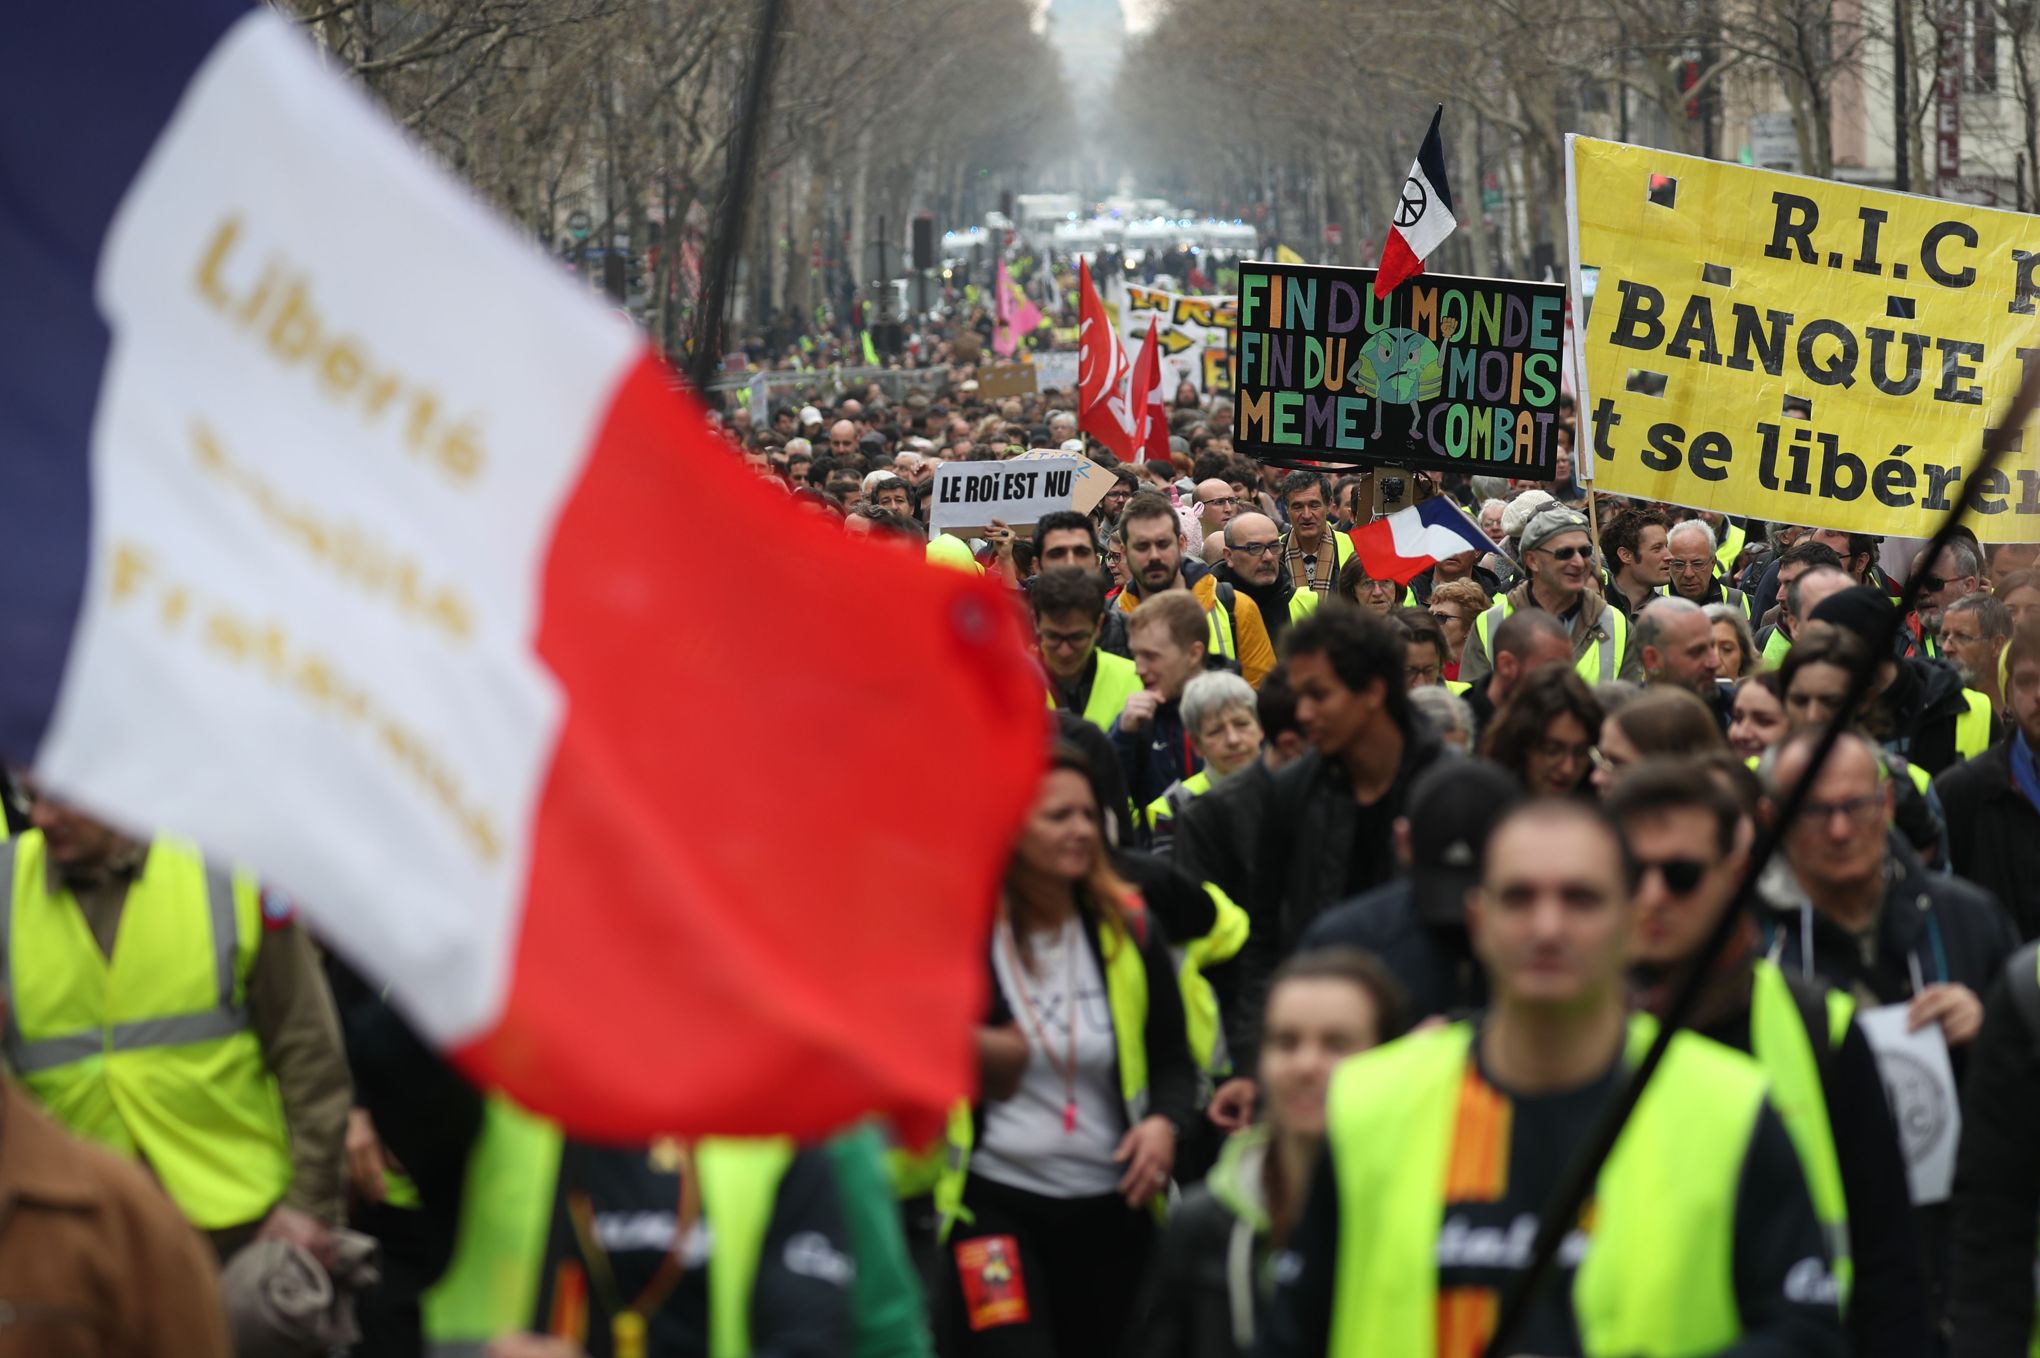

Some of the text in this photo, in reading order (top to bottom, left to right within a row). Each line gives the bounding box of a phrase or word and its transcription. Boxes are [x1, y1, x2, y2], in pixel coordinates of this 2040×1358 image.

[1764, 191, 1979, 288] R.I.C
[1242, 274, 1561, 351] FIN DU MONDE
[1609, 279, 1985, 406] BANQUE
[1241, 331, 1558, 407] FIN DU MOIS
[1427, 402, 1555, 466] COMBAT
[1640, 423, 1733, 481] se
[940, 476, 961, 503] LE
[1003, 472, 1038, 500] EST
[1044, 470, 1072, 498] NU
